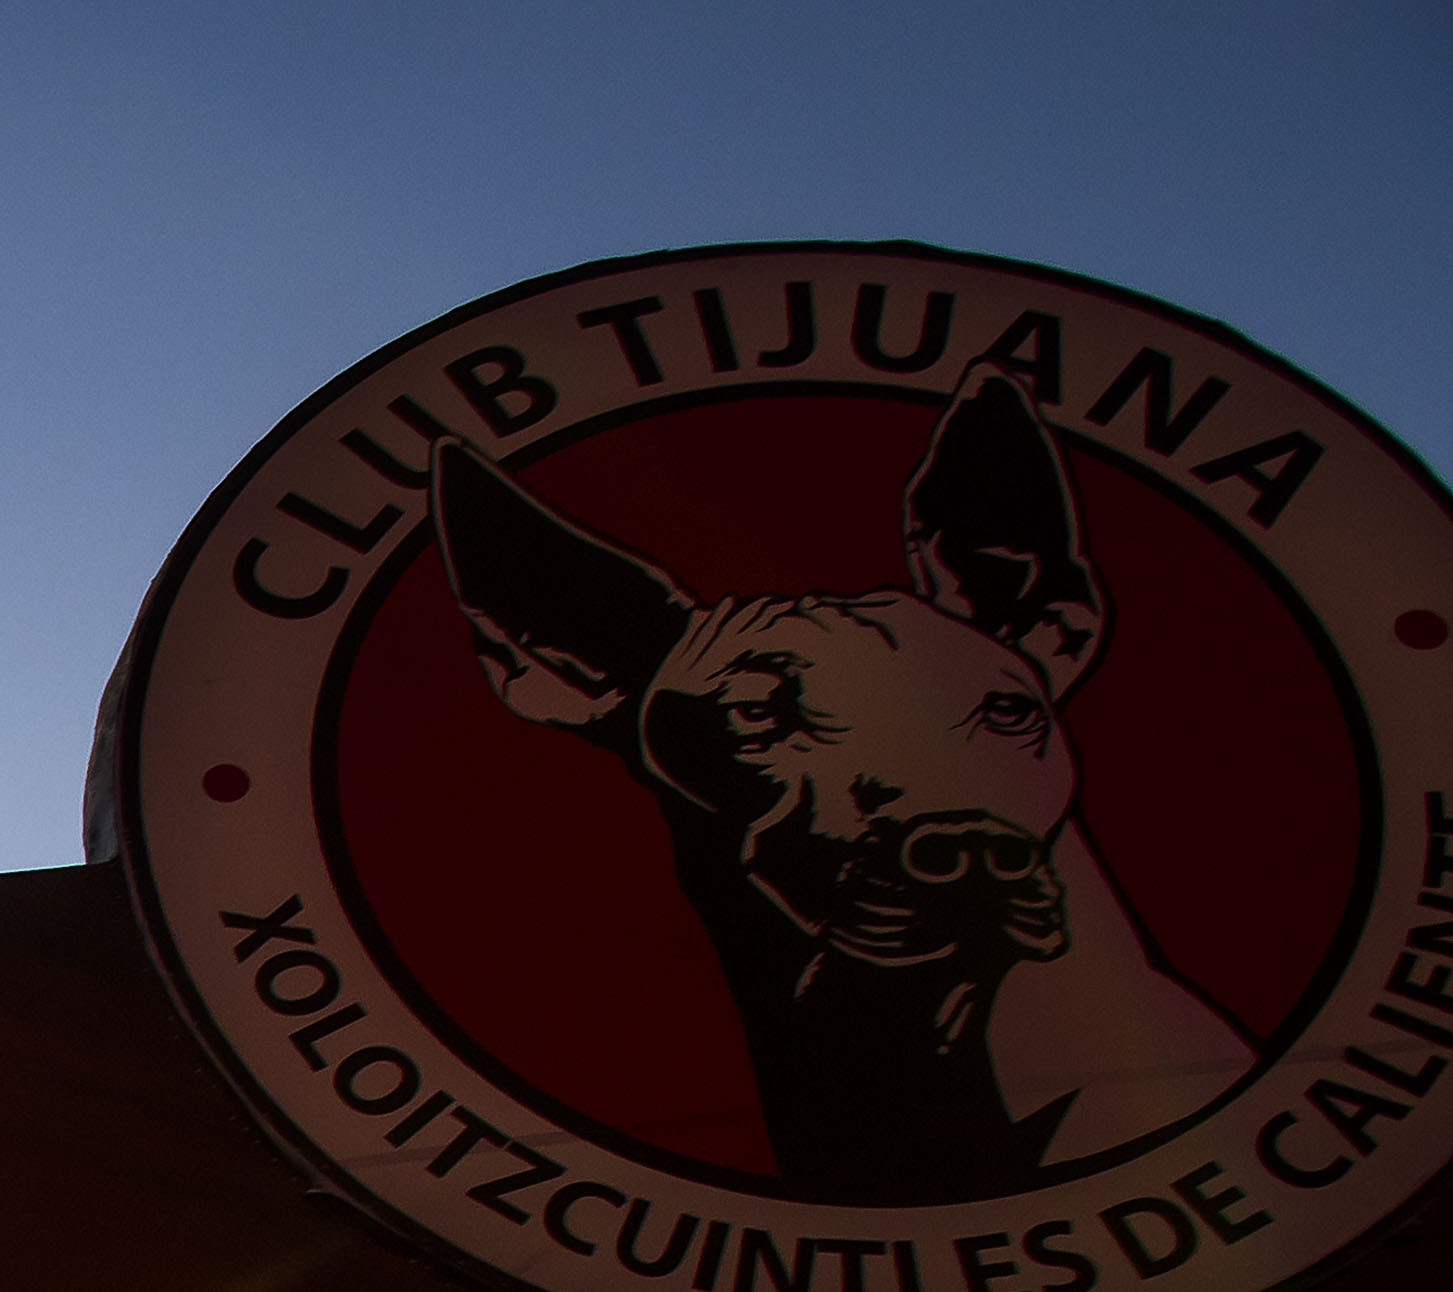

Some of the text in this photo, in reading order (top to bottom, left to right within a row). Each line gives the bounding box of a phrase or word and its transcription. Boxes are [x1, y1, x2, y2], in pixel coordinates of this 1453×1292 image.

[230, 280, 1328, 621] CLUB TIJUANA
[1099, 1161, 1273, 1281] DE
